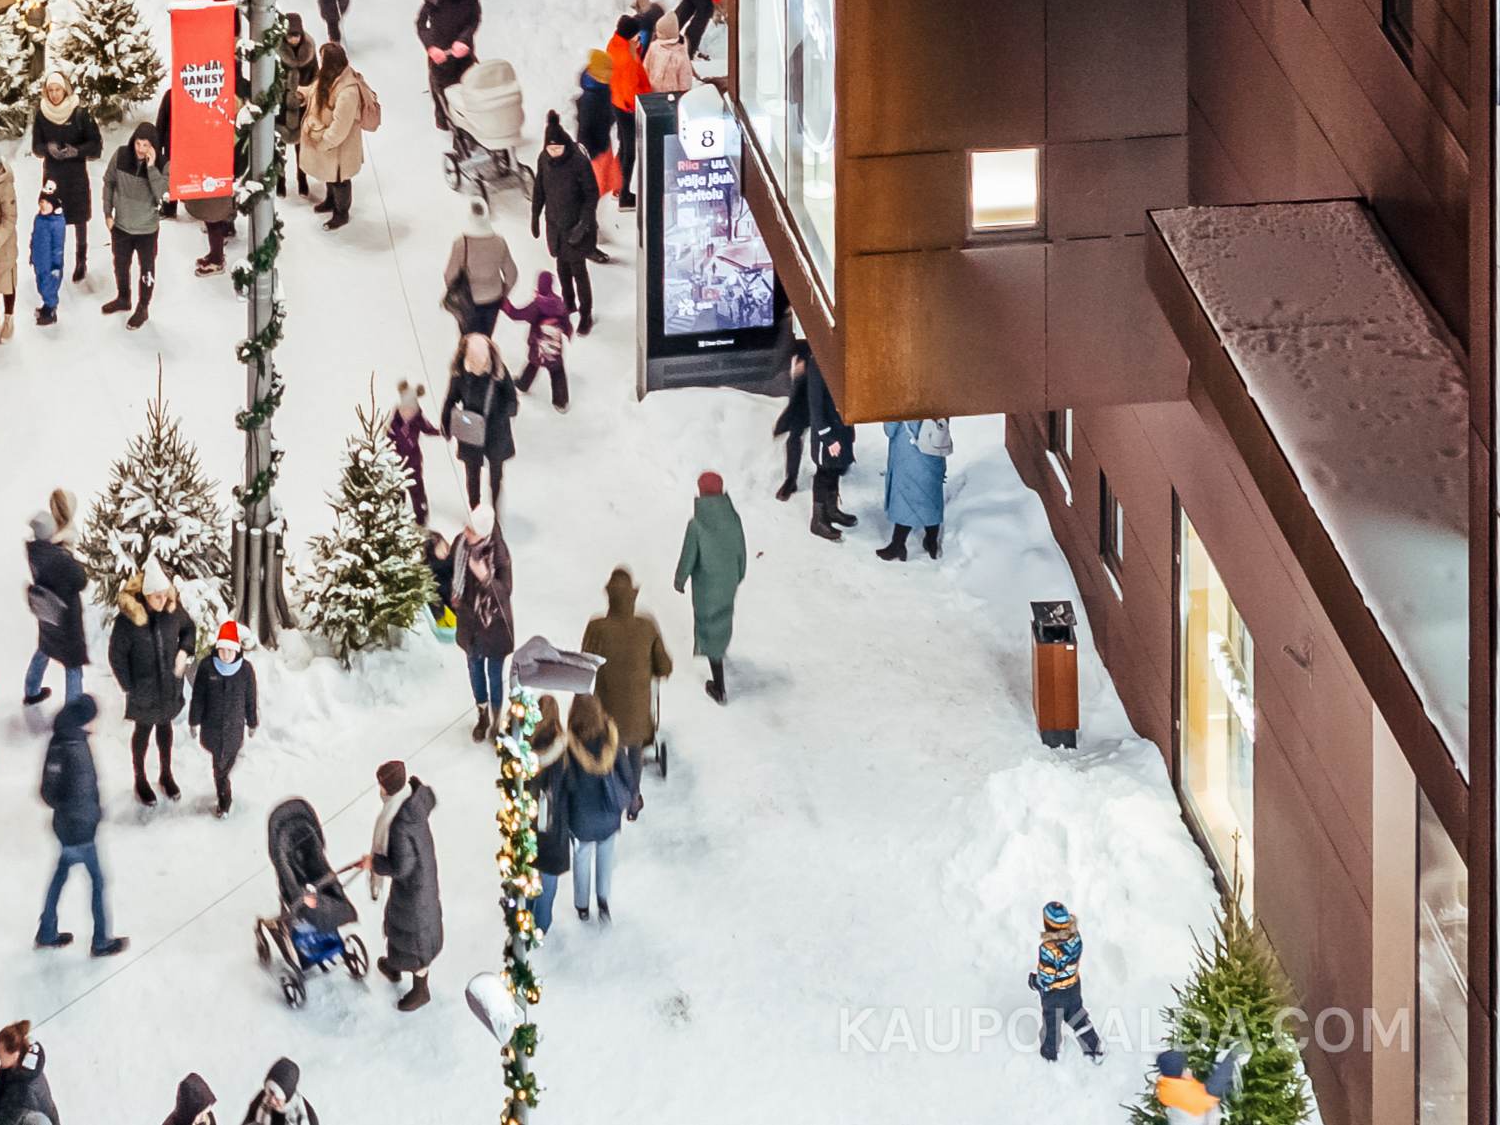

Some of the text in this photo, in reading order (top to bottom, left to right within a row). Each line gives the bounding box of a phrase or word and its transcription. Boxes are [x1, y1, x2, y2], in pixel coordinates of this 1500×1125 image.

[701, 130, 714, 147] 8
[678, 160, 700, 171] Riia
[677, 173, 707, 189] välja
